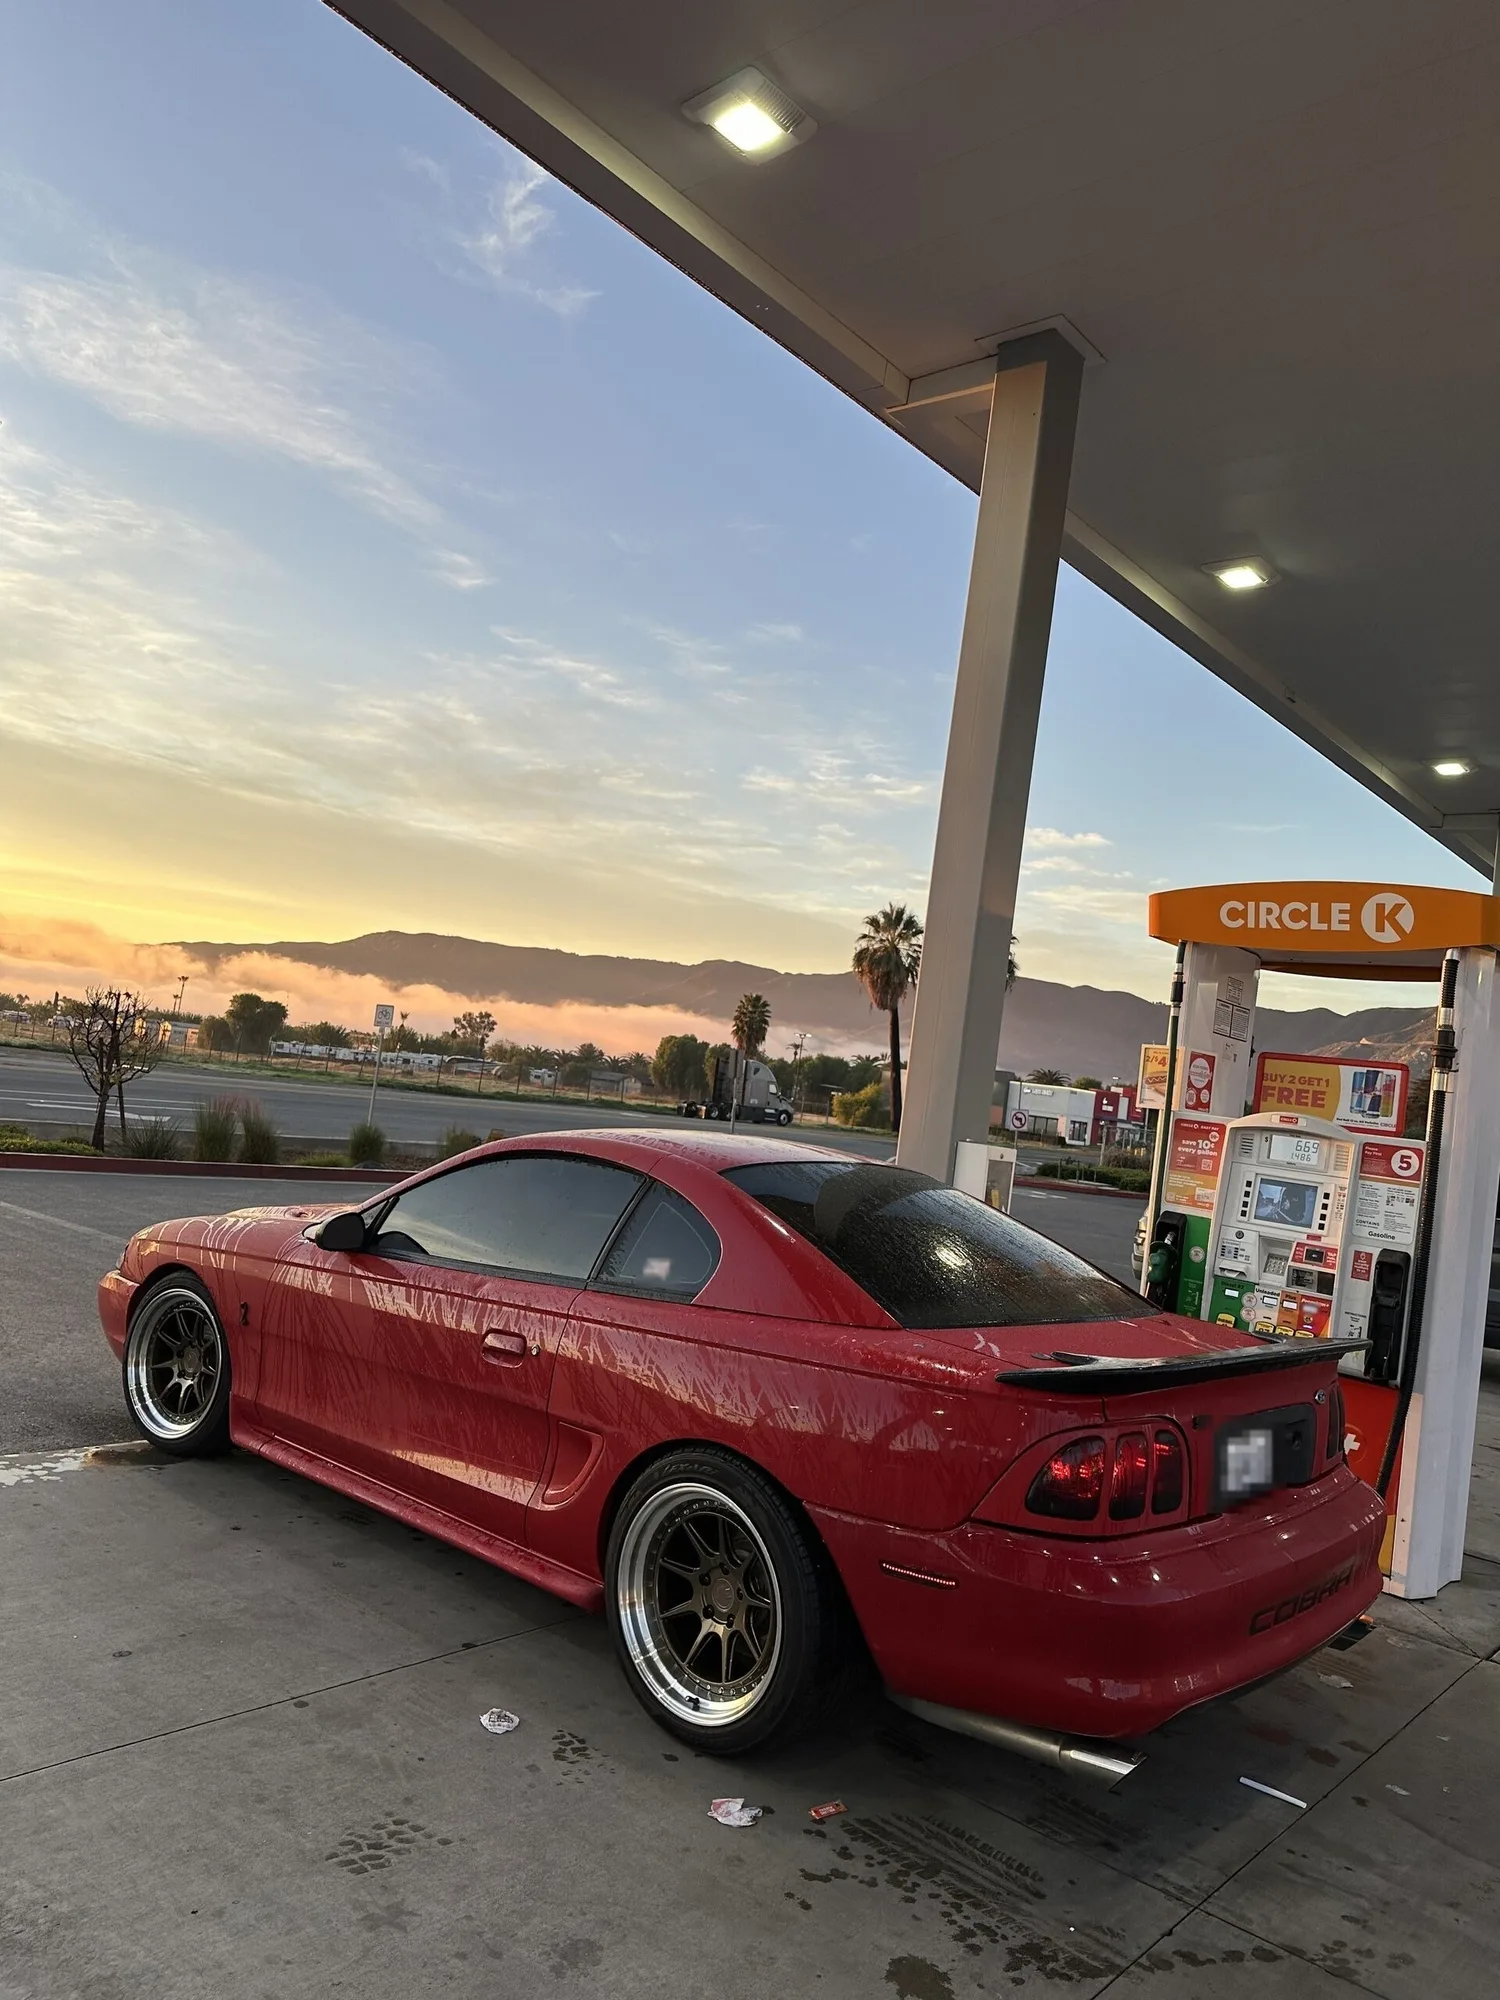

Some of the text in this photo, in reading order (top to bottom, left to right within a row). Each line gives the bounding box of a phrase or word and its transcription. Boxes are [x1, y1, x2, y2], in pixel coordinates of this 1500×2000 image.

[1219, 898, 1413, 941] CIRCLE K
[1263, 1073, 1330, 1088] BUY 2 GET 1
[1262, 1086, 1327, 1109] FREE
[1178, 1146, 1196, 1154] every
[1398, 1154, 1412, 1171] 5
[1355, 1219, 1380, 1227] CONTAINS
[1368, 1231, 1395, 1240] Gasoline
[1255, 1287, 1280, 1297] Unleaded
[1249, 1557, 1356, 1636] COBRA
